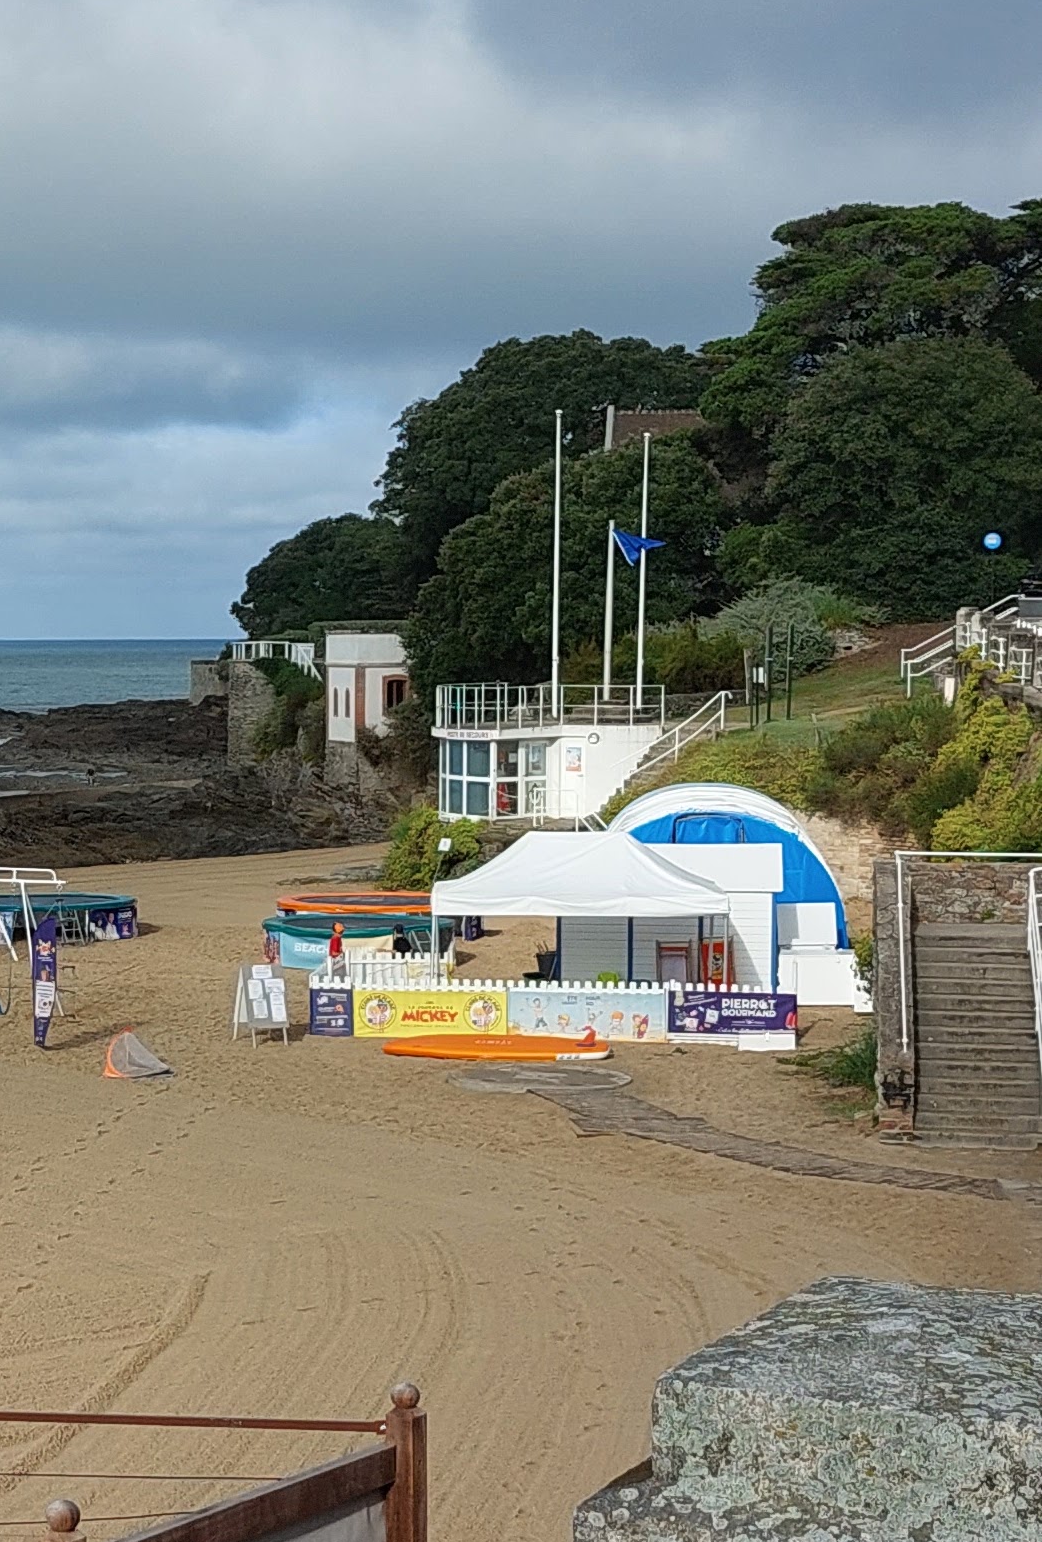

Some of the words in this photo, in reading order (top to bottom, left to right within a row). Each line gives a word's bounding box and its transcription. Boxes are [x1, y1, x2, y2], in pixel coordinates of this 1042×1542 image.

[721, 998, 778, 1010] PIERROT
[401, 1010, 458, 1023] MICKEY
[721, 1009, 777, 1018] GOURMAND
